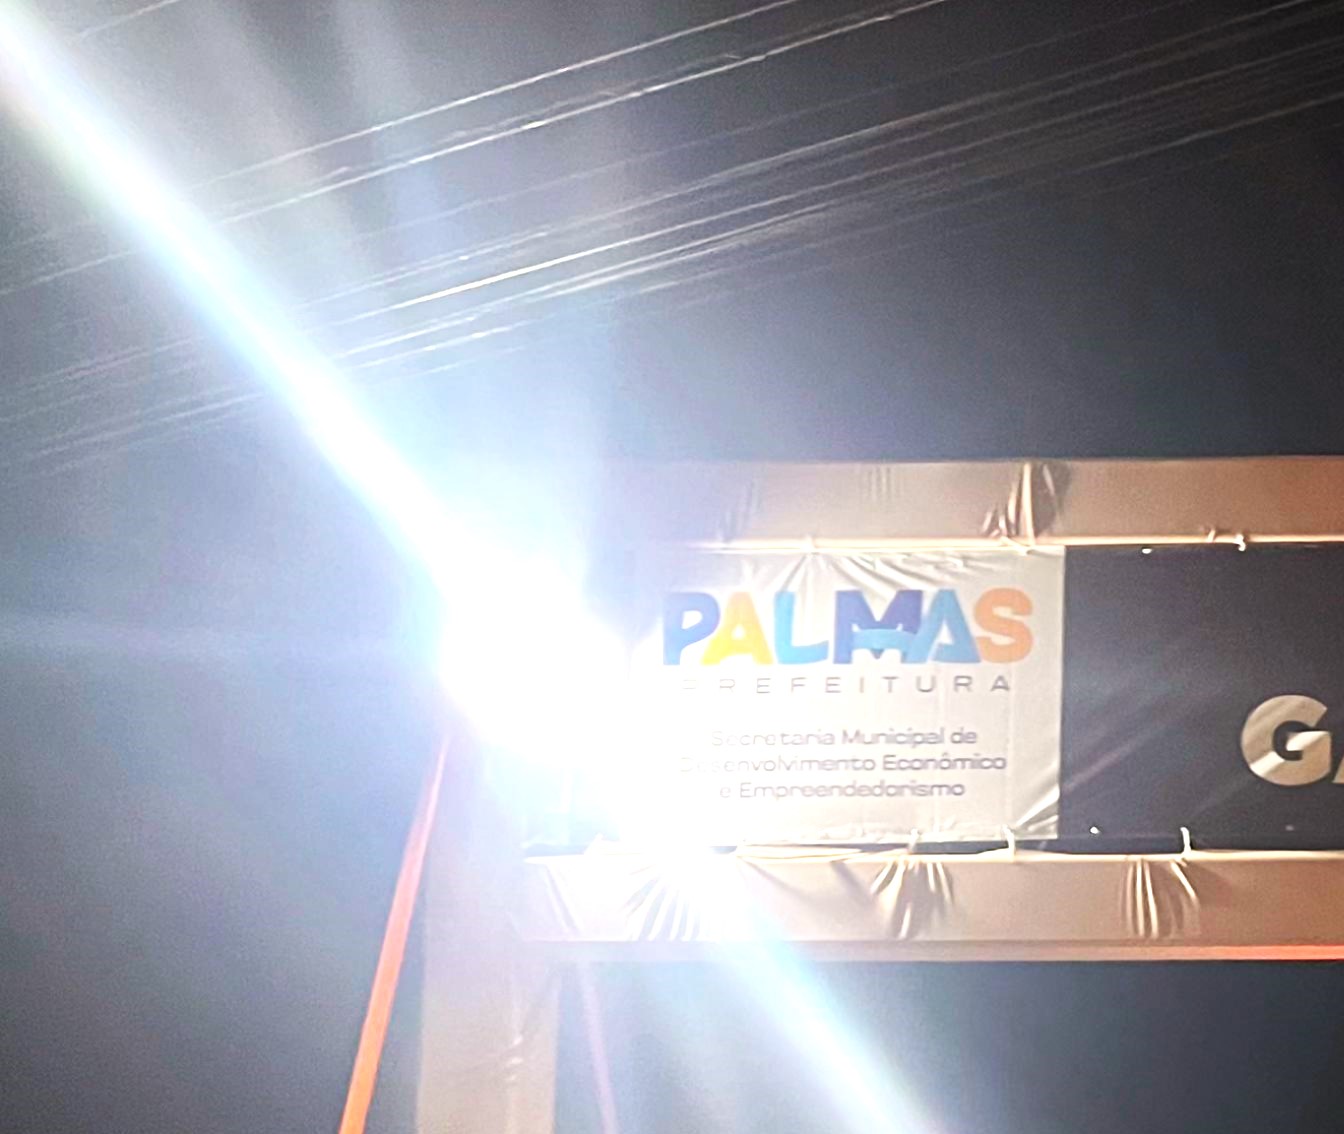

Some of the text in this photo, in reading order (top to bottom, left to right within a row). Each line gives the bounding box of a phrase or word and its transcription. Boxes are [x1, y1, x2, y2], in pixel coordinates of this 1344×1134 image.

[662, 587, 1034, 666] PALMAS
[711, 726, 978, 750] Secretaria Municipal de
[882, 752, 1008, 772] Econômico
[740, 777, 966, 801] Empreendedorismo
